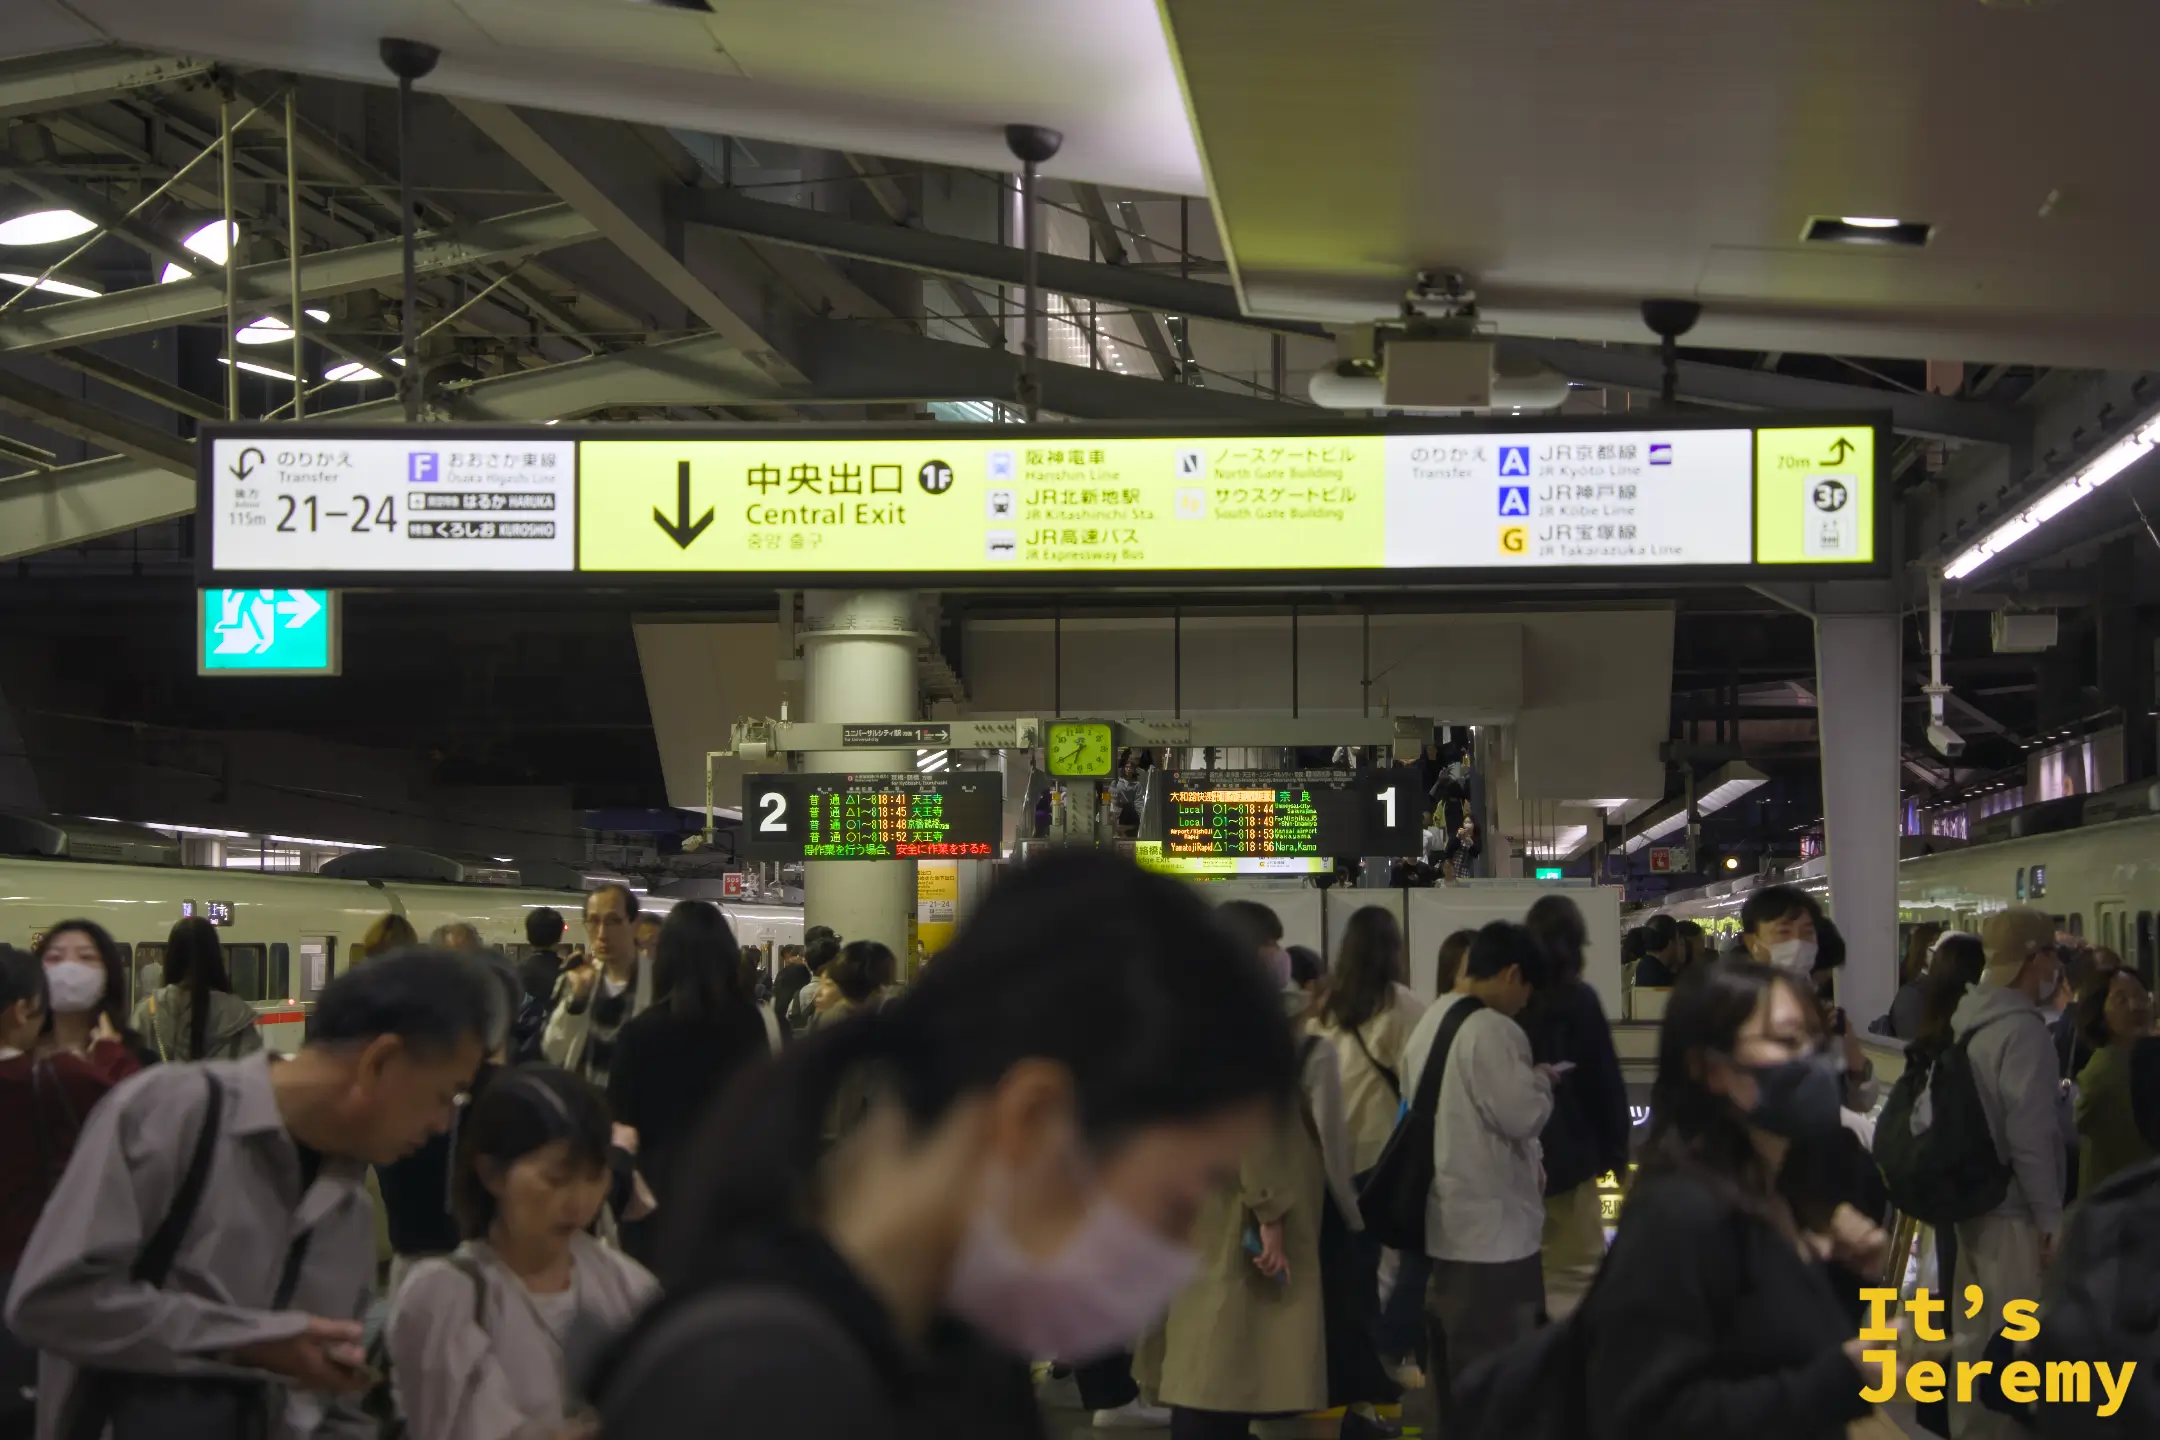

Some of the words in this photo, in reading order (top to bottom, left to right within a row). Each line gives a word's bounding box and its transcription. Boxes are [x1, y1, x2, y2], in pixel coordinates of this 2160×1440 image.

[277, 451, 353, 468] のりかえ
[449, 452, 556, 468] おおさか東線
[1025, 449, 1105, 465] 阪神電車
[1214, 447, 1356, 463] ノースゲートビル
[1411, 447, 1487, 462] のりかえ
[1539, 444, 1638, 461] JR京都線
[415, 455, 432, 480] F
[1502, 448, 1527, 474] A
[1777, 455, 1811, 470] 70m
[280, 471, 339, 483] Transfer
[532, 472, 556, 483] Line
[1025, 469, 1085, 480] Hanshin
[1090, 469, 1120, 480] Line
[1214, 468, 1250, 479] North
[1254, 468, 1285, 479] Gate
[1289, 467, 1343, 480] Building
[1413, 467, 1473, 479] Transfer
[1539, 465, 1554, 476] JR
[1610, 464, 1642, 476] Line
[747, 462, 903, 495] 中央出口
[923, 465, 951, 489] 1F
[1025, 488, 1140, 505] JR北新地駅
[1215, 487, 1357, 503] サウスゲートビル
[1539, 484, 1638, 501] JR神戸線
[1816, 485, 1844, 508] 3F
[463, 494, 507, 509] はるか
[1502, 488, 1527, 514] A
[229, 511, 266, 525] 115m
[276, 494, 397, 532] 21-24
[746, 502, 844, 525] Central
[855, 501, 907, 525] Exit
[1025, 509, 1041, 521] JR
[1215, 507, 1251, 519] South
[1255, 507, 1285, 519] Gate
[1290, 507, 1344, 521] Building
[1539, 505, 1554, 517] JR
[1603, 504, 1635, 517] Line
[436, 522, 496, 538] くろしお
[500, 523, 554, 537] KUROSHIO
[1025, 528, 1139, 545] JR高速バス
[1539, 523, 1638, 541] JR宝塚線
[1503, 529, 1524, 552] G
[1025, 550, 1039, 560] JR
[1044, 550, 1117, 563] Expressway
[1122, 550, 1144, 560] Bus
[1539, 546, 1554, 557] JR
[1560, 544, 1646, 557] Takarazuka
[1650, 543, 1684, 556] Line
[844, 729, 901, 737] ユニバーサルシティ駅
[915, 729, 921, 741] 1
[878, 794, 906, 805] 18:41
[912, 793, 943, 805] 天王寺
[759, 792, 787, 832] 2
[878, 807, 907, 817] 18:45
[912, 806, 943, 817] 天王寺
[1179, 804, 1204, 814] Local
[1245, 804, 1274, 814] 18:44
[1377, 787, 1396, 827] 1
[878, 819, 907, 830] 18:48
[1179, 817, 1204, 826] Local
[1245, 817, 1274, 827] 18:49
[878, 832, 907, 842] 18:52
[912, 831, 943, 842] 天王寺
[1245, 829, 1274, 839] 18:53
[896, 843, 991, 855] 安全に作業をするた
[1245, 842, 1275, 851] 18:56
